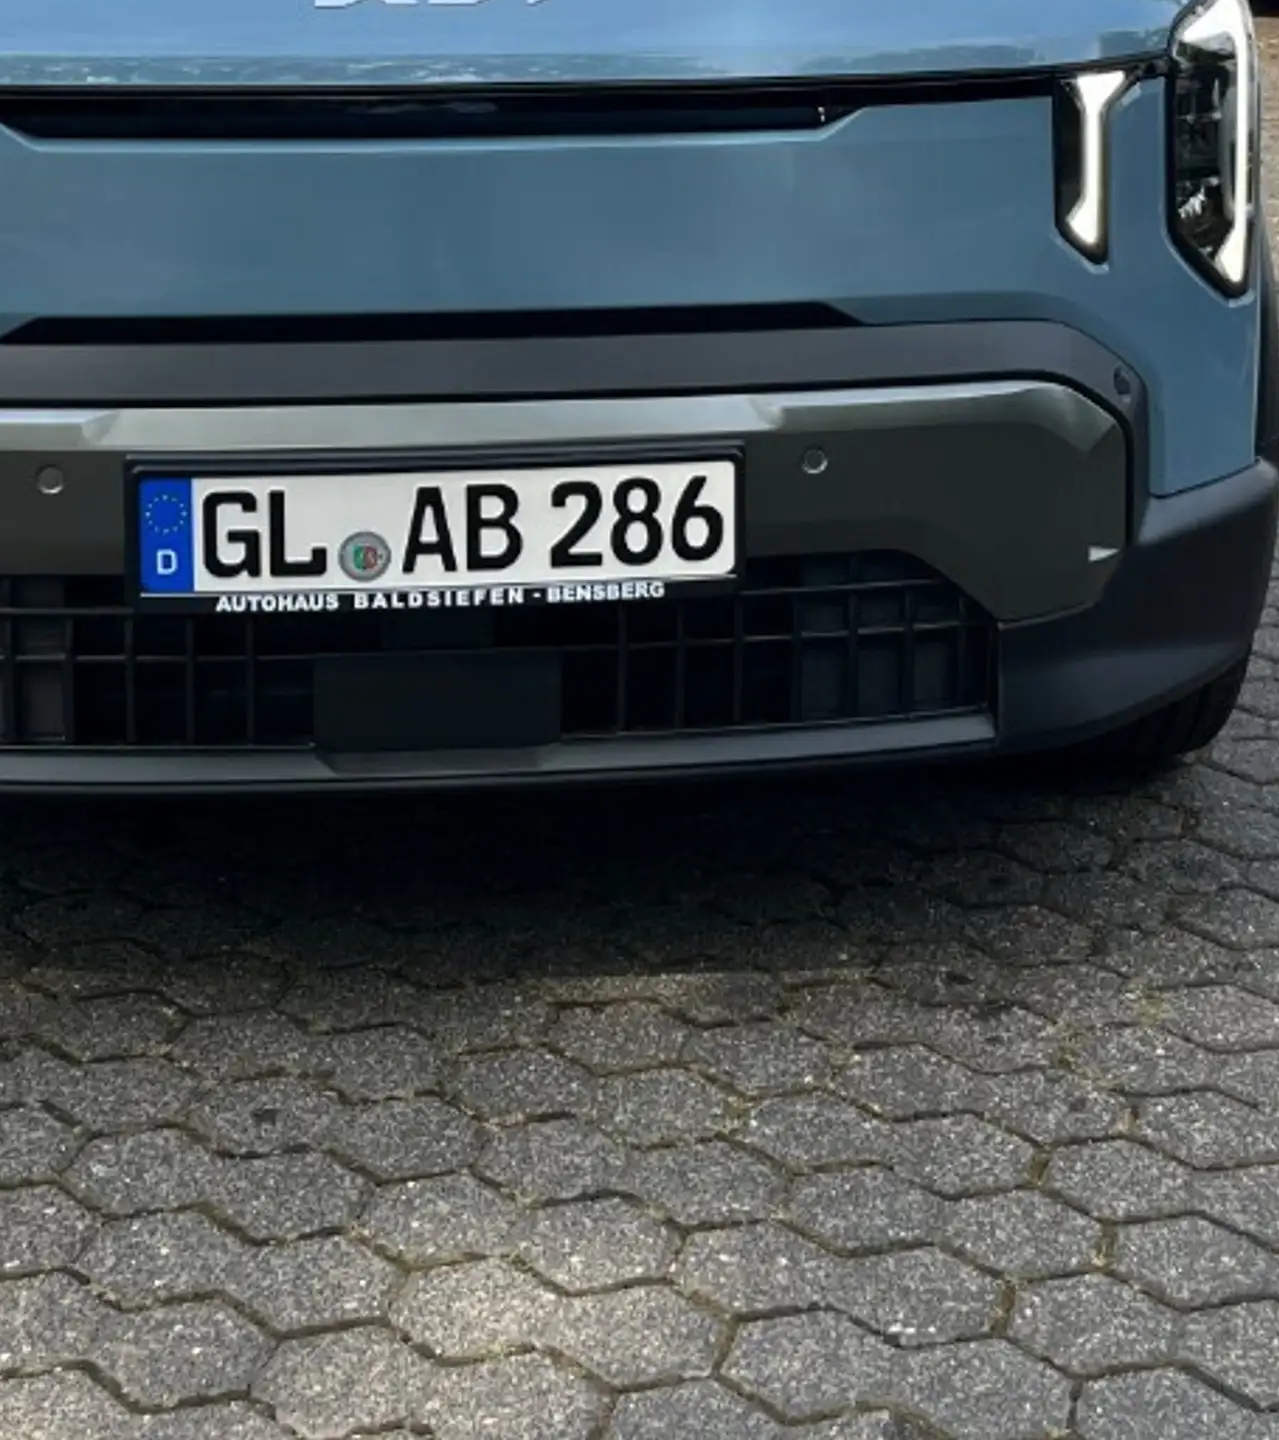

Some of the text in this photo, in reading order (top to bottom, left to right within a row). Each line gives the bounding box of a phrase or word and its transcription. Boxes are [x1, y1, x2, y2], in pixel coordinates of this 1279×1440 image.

[156, 475, 724, 579] D GL AB 286
[216, 593, 339, 613] AUTOHAUS
[354, 586, 524, 610] BALDSIEFEN
[547, 580, 666, 604] BENSBERG
